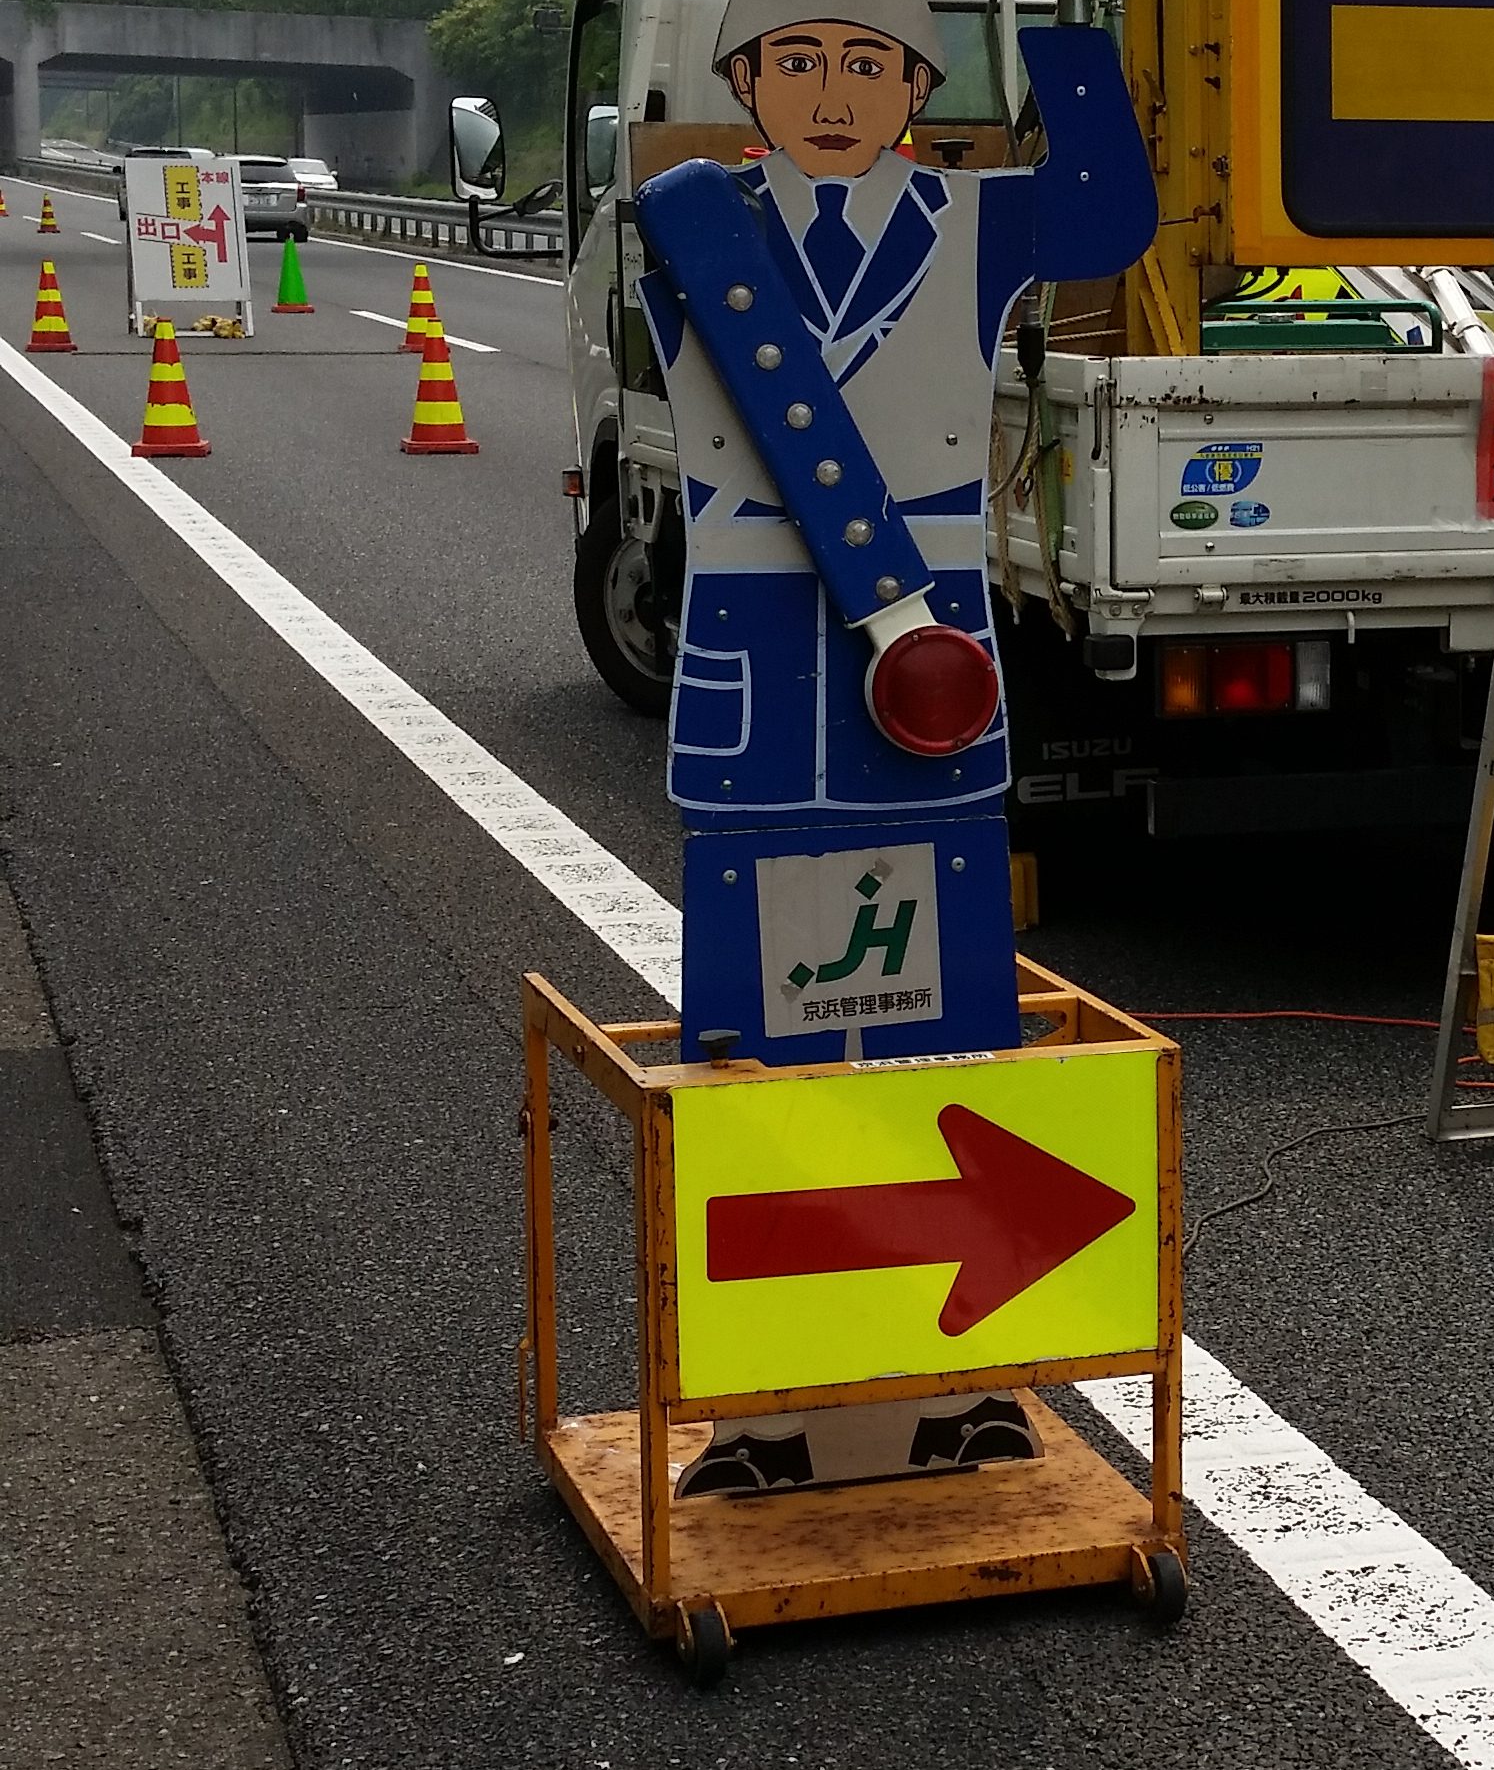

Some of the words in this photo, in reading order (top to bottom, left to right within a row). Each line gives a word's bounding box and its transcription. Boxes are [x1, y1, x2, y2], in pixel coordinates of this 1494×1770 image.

[176, 182, 191, 209] 工事
[137, 217, 181, 240] 出口
[182, 253, 197, 280] 工事
[1042, 737, 1132, 760] ISUZU
[1018, 768, 1159, 804] ELF
[802, 987, 932, 1021] 京浜管理事務所
